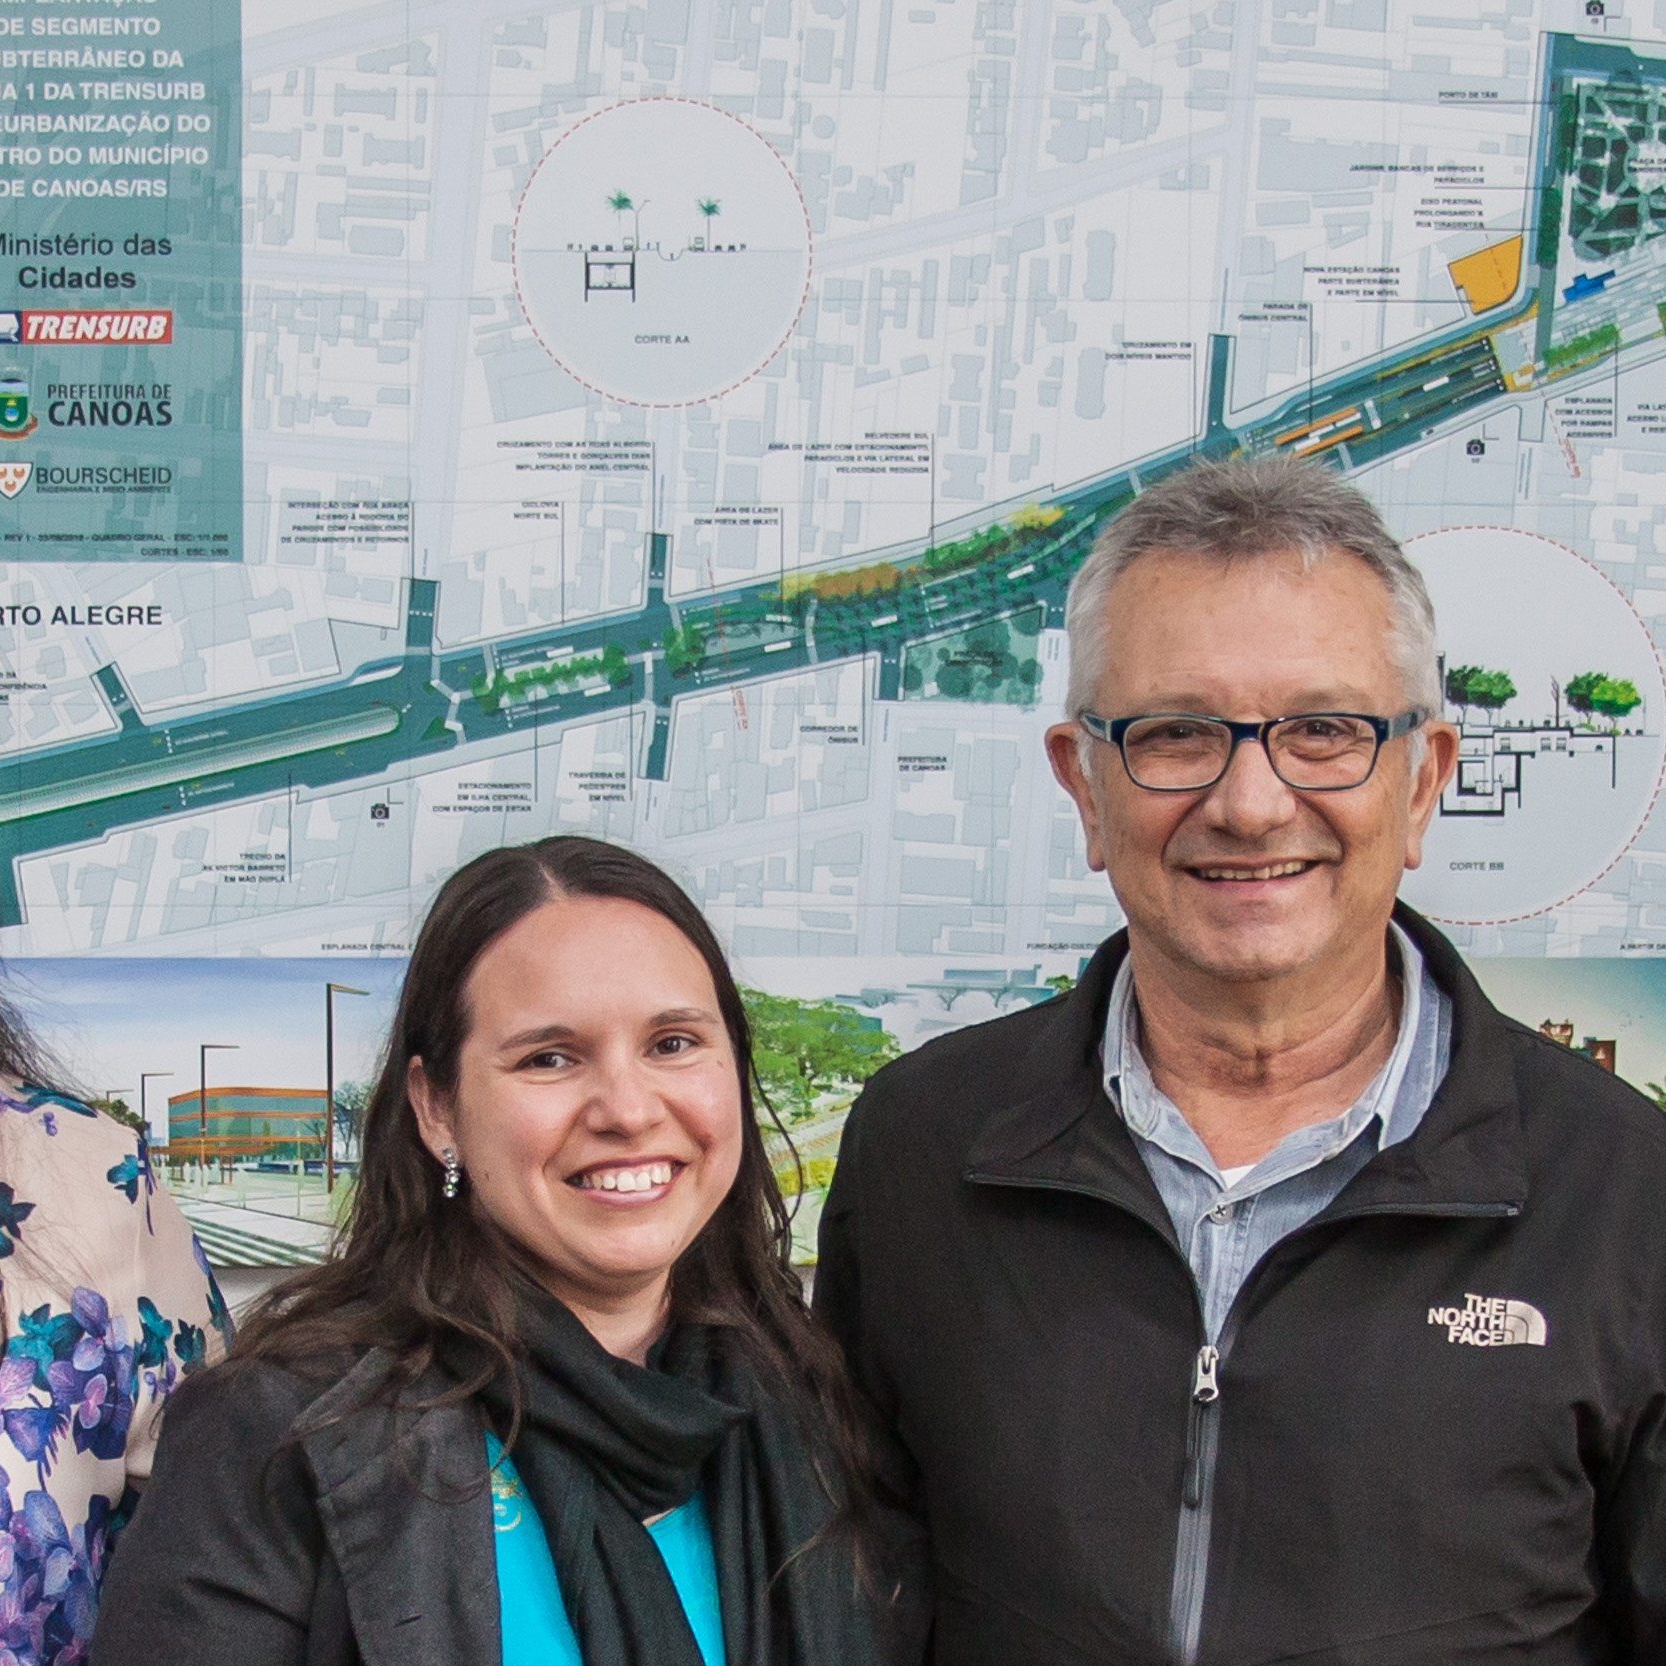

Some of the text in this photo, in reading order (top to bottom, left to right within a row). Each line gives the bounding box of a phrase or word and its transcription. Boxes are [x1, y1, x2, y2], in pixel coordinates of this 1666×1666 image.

[32, 17, 160, 35] SEGMENTO
[153, 50, 183, 67] DA
[27, 83, 34, 100] 1
[44, 82, 74, 100] DA
[79, 82, 205, 100] TRENSURB
[177, 114, 210, 133] DO
[49, 146, 82, 165] DO
[89, 146, 208, 164] MUNICÍPIO
[32, 179, 167, 197] CANOAS/RS
[124, 234, 171, 255] das
[18, 267, 136, 288] Cidades
[26, 314, 167, 341] TRENSURB
[635, 335, 671, 344] CORTE
[48, 384, 171, 399] PREFEITURA DE
[48, 401, 171, 426] CANOAS
[36, 467, 172, 484] BOURSCHEID
[52, 606, 161, 625] ALEGRE
[1464, 1293, 1506, 1315] THE
[1427, 1307, 1505, 1330] NORTH
[1447, 1326, 1504, 1346] FACE
